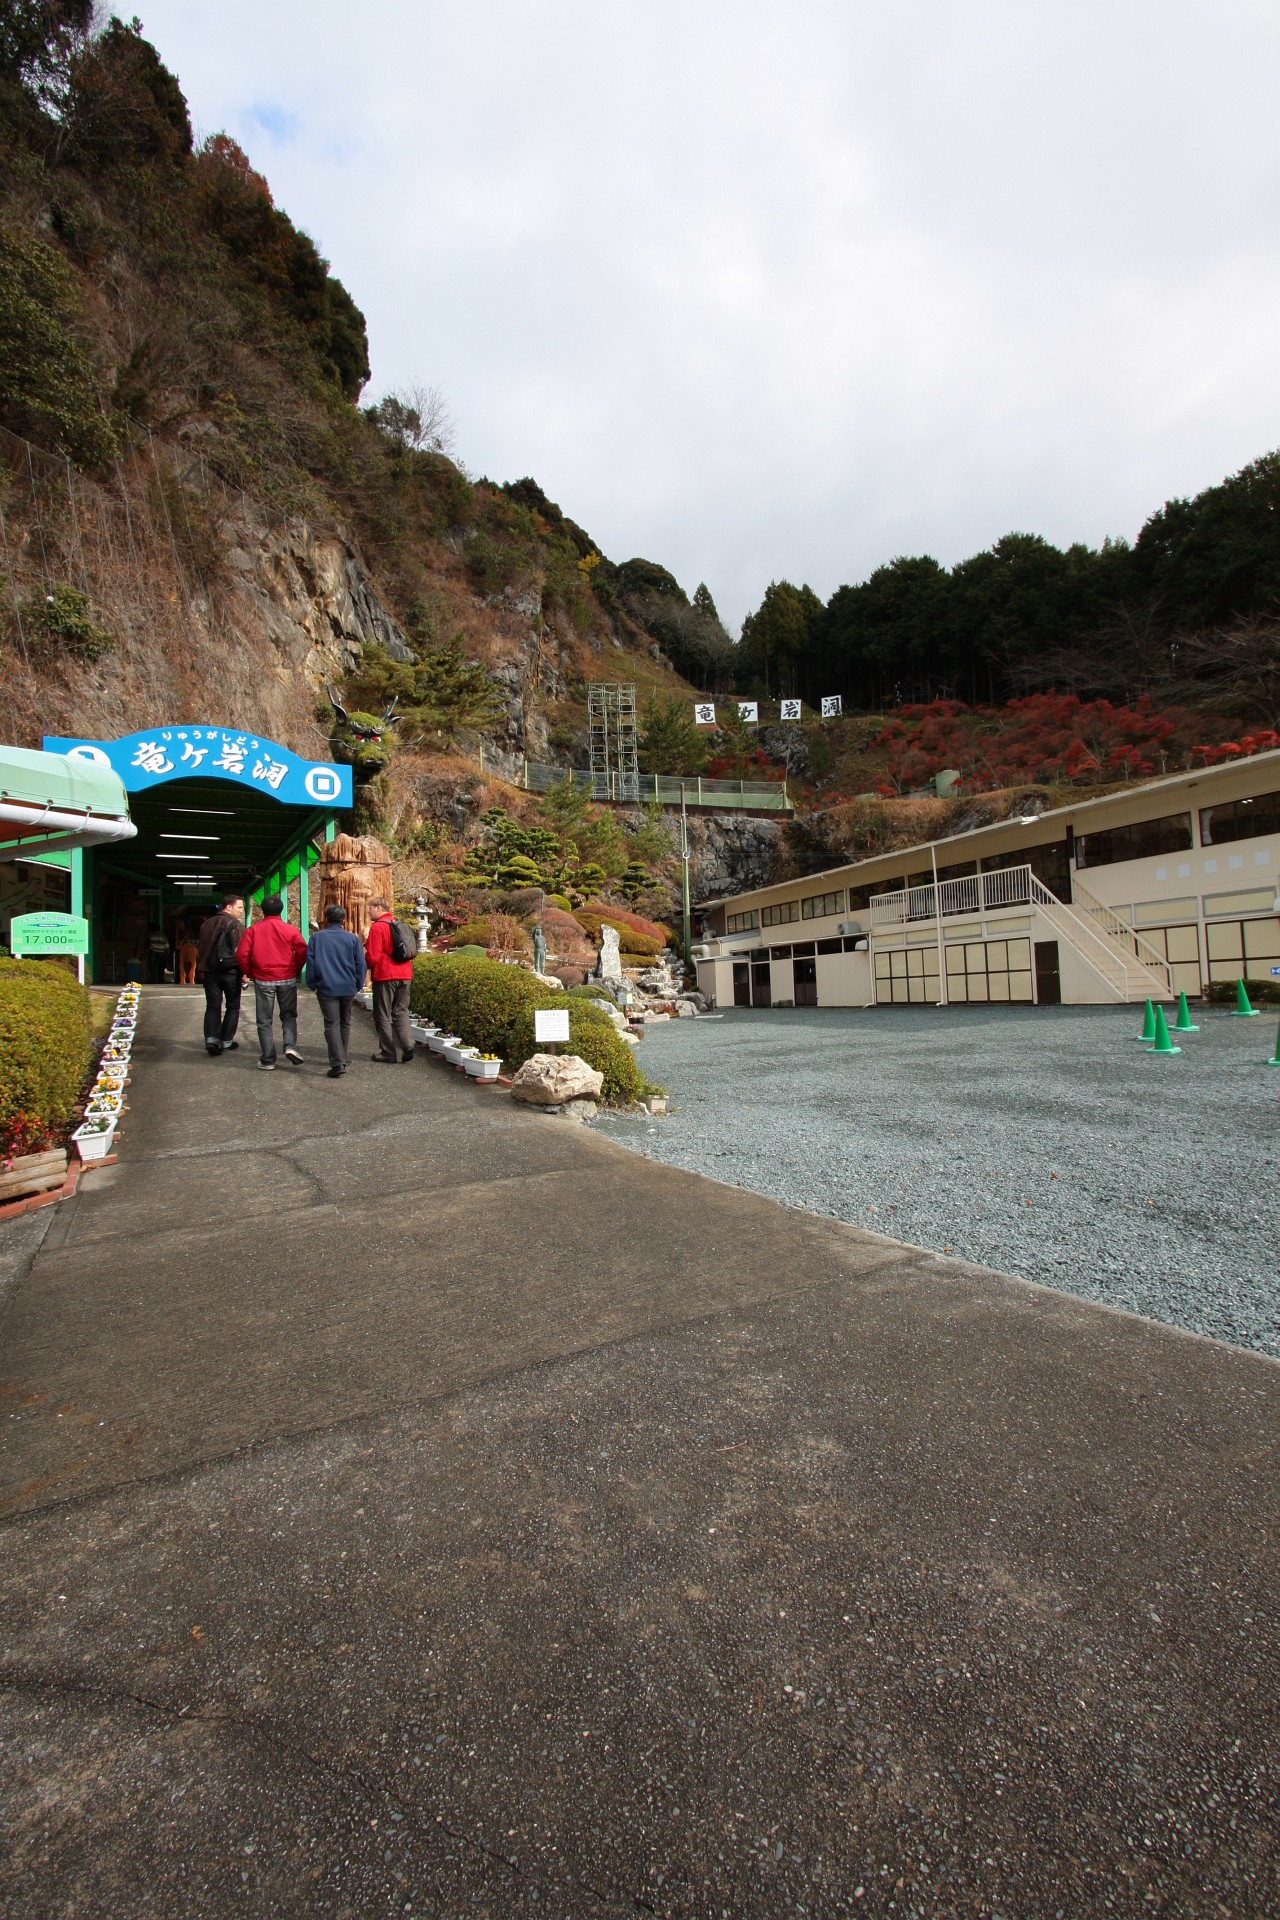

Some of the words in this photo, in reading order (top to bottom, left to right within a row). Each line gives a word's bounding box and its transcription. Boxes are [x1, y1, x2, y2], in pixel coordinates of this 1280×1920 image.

[161, 730, 259, 750] りゅうがしどう
[25, 935, 67, 944] 17,000
